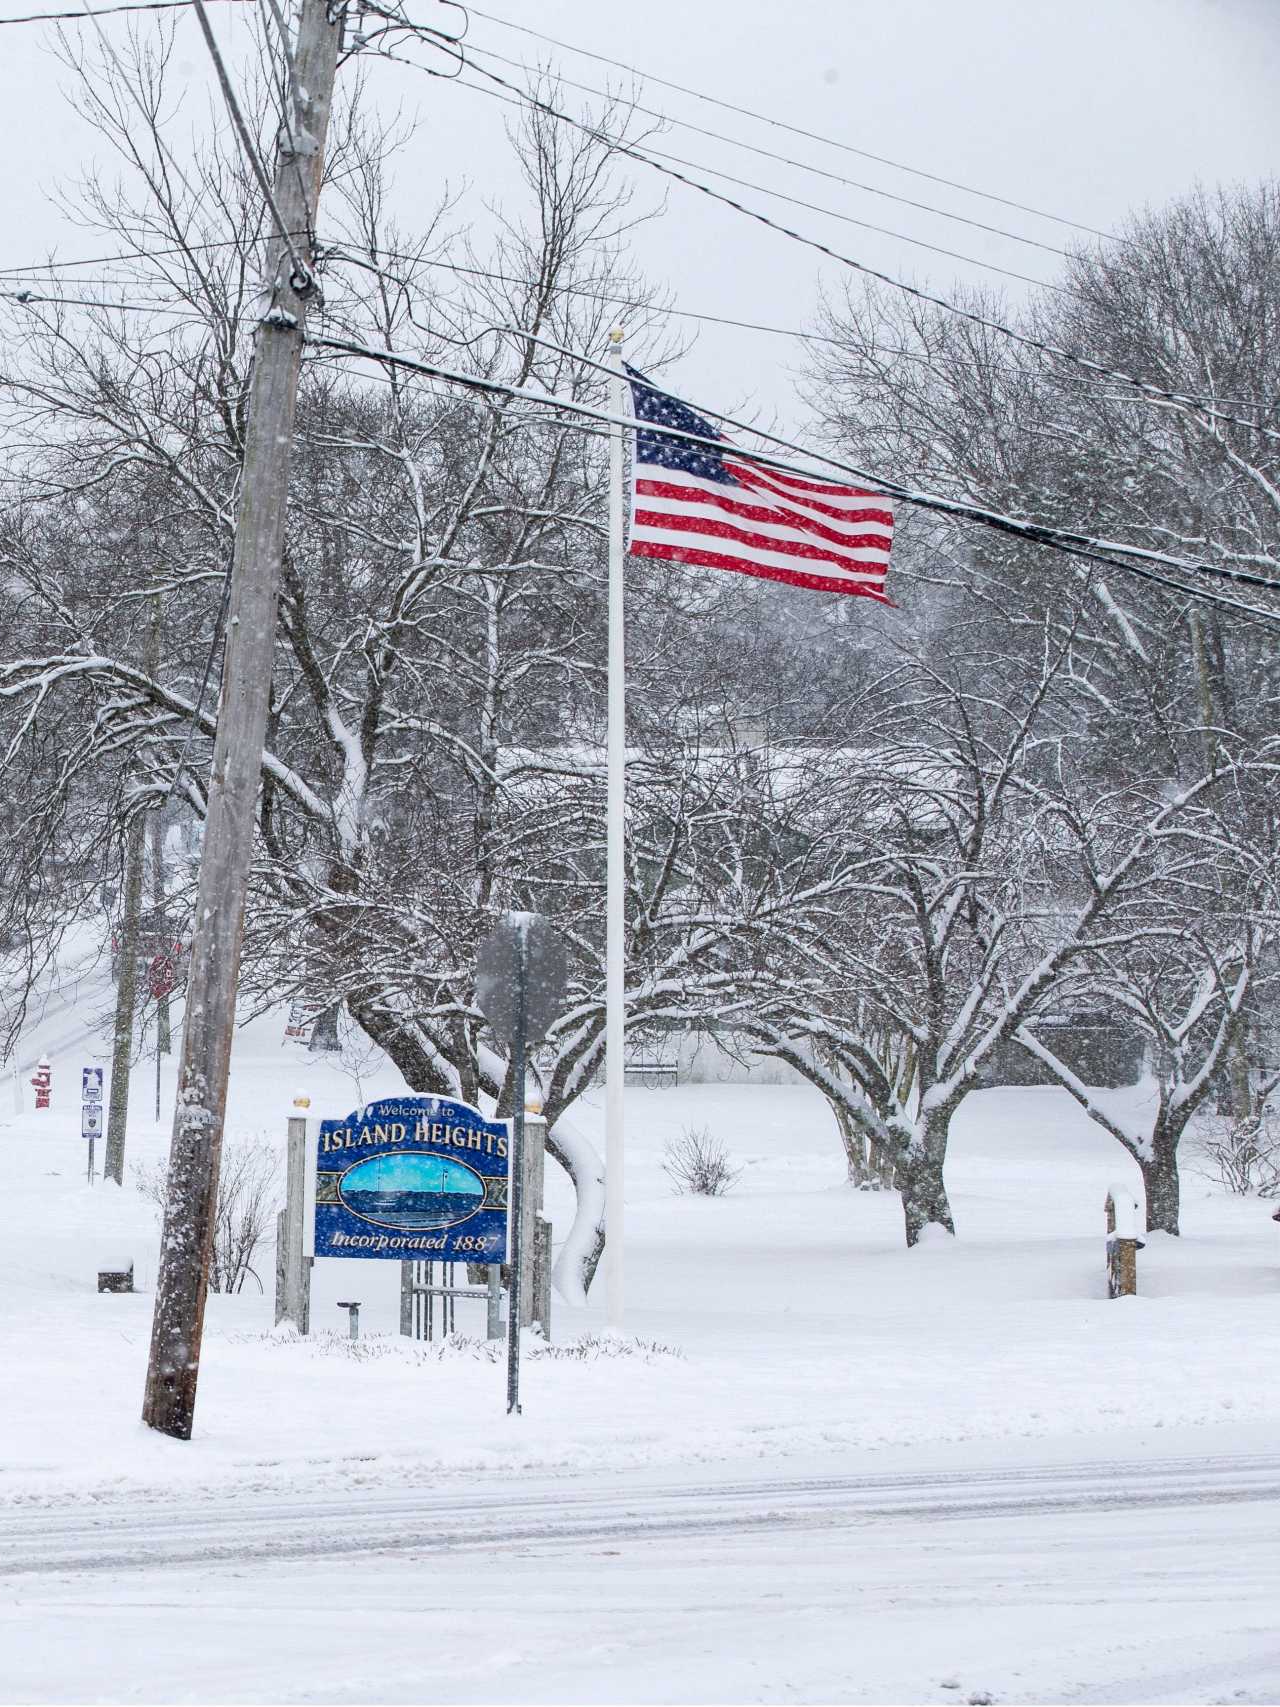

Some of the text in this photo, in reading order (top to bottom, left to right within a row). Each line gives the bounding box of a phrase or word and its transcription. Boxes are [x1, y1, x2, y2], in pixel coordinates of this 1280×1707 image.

[442, 1107, 455, 1116] to
[323, 1121, 508, 1158] ISLAND HEIGHTS
[331, 1231, 498, 1251] Incorporated 1887
